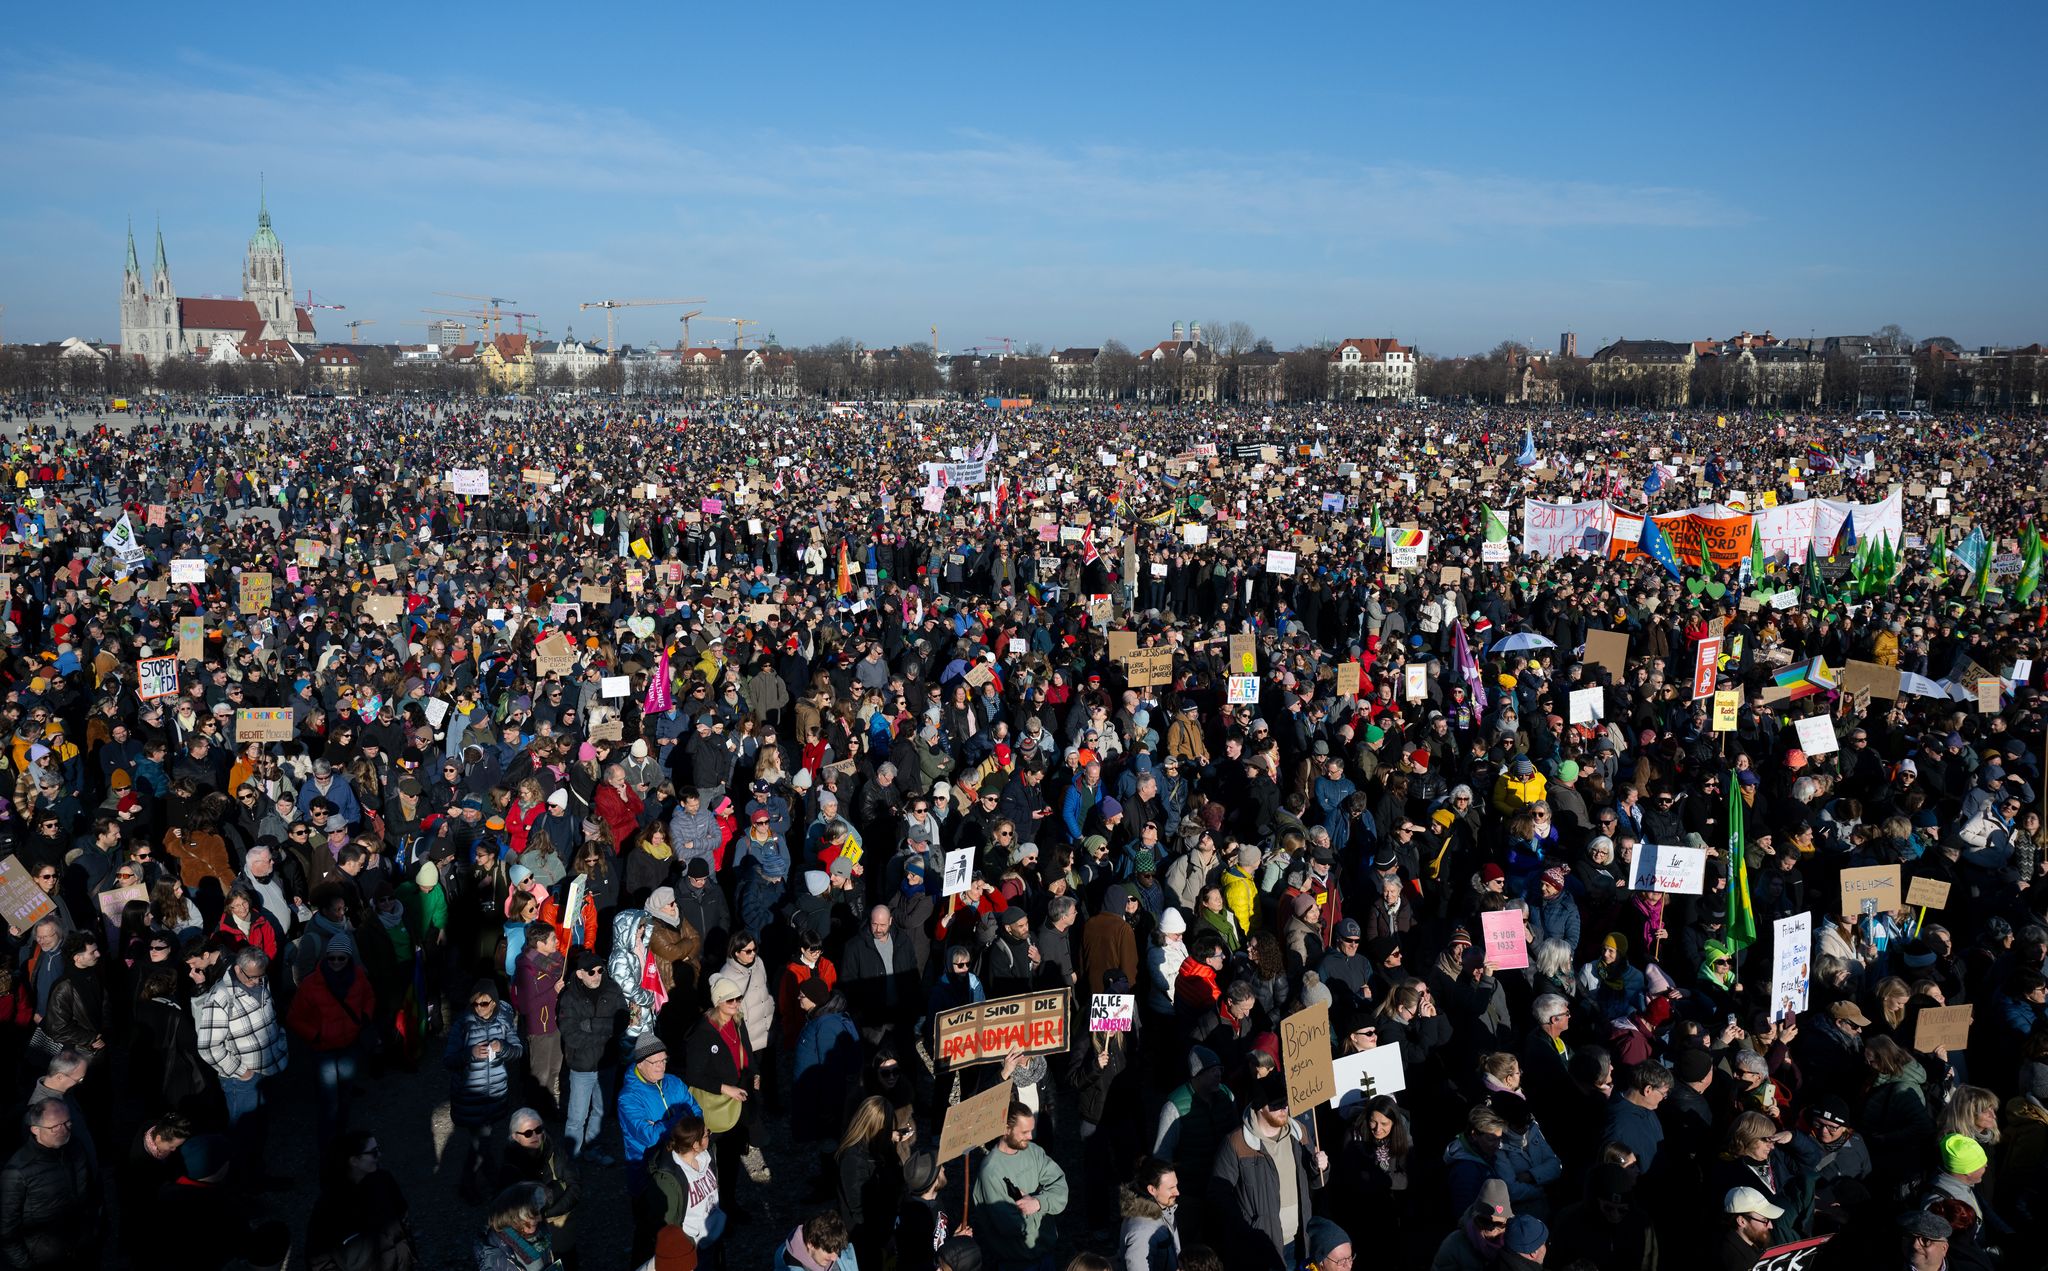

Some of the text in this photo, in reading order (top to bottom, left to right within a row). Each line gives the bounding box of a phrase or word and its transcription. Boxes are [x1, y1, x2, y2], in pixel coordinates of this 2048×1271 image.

[1818, 476, 1838, 484] FCK
[1820, 482, 1839, 490] NZS
[1732, 524, 1748, 537] IST
[141, 659, 176, 678] STOPPT
[1231, 678, 1256, 688] VIEL
[1230, 688, 1256, 698] FALT
[237, 711, 293, 721] MENSCHENRECHTE
[240, 730, 264, 740] RECHTE
[1635, 873, 1684, 890] AfD-Verbot
[14, 892, 47, 920] FRITZE
[1500, 931, 1516, 939] VOR
[1497, 941, 1515, 950] 1933
[1092, 995, 1121, 1007] ALICE
[948, 998, 1057, 1026] WIR SIND DIE
[1091, 1007, 1109, 1019] INS
[943, 1018, 1063, 1062] BRANDMAUER!
[1285, 1020, 1326, 1060] Björns
[1291, 1058, 1313, 1080] gegen
[1291, 1076, 1323, 1106] Rechts
